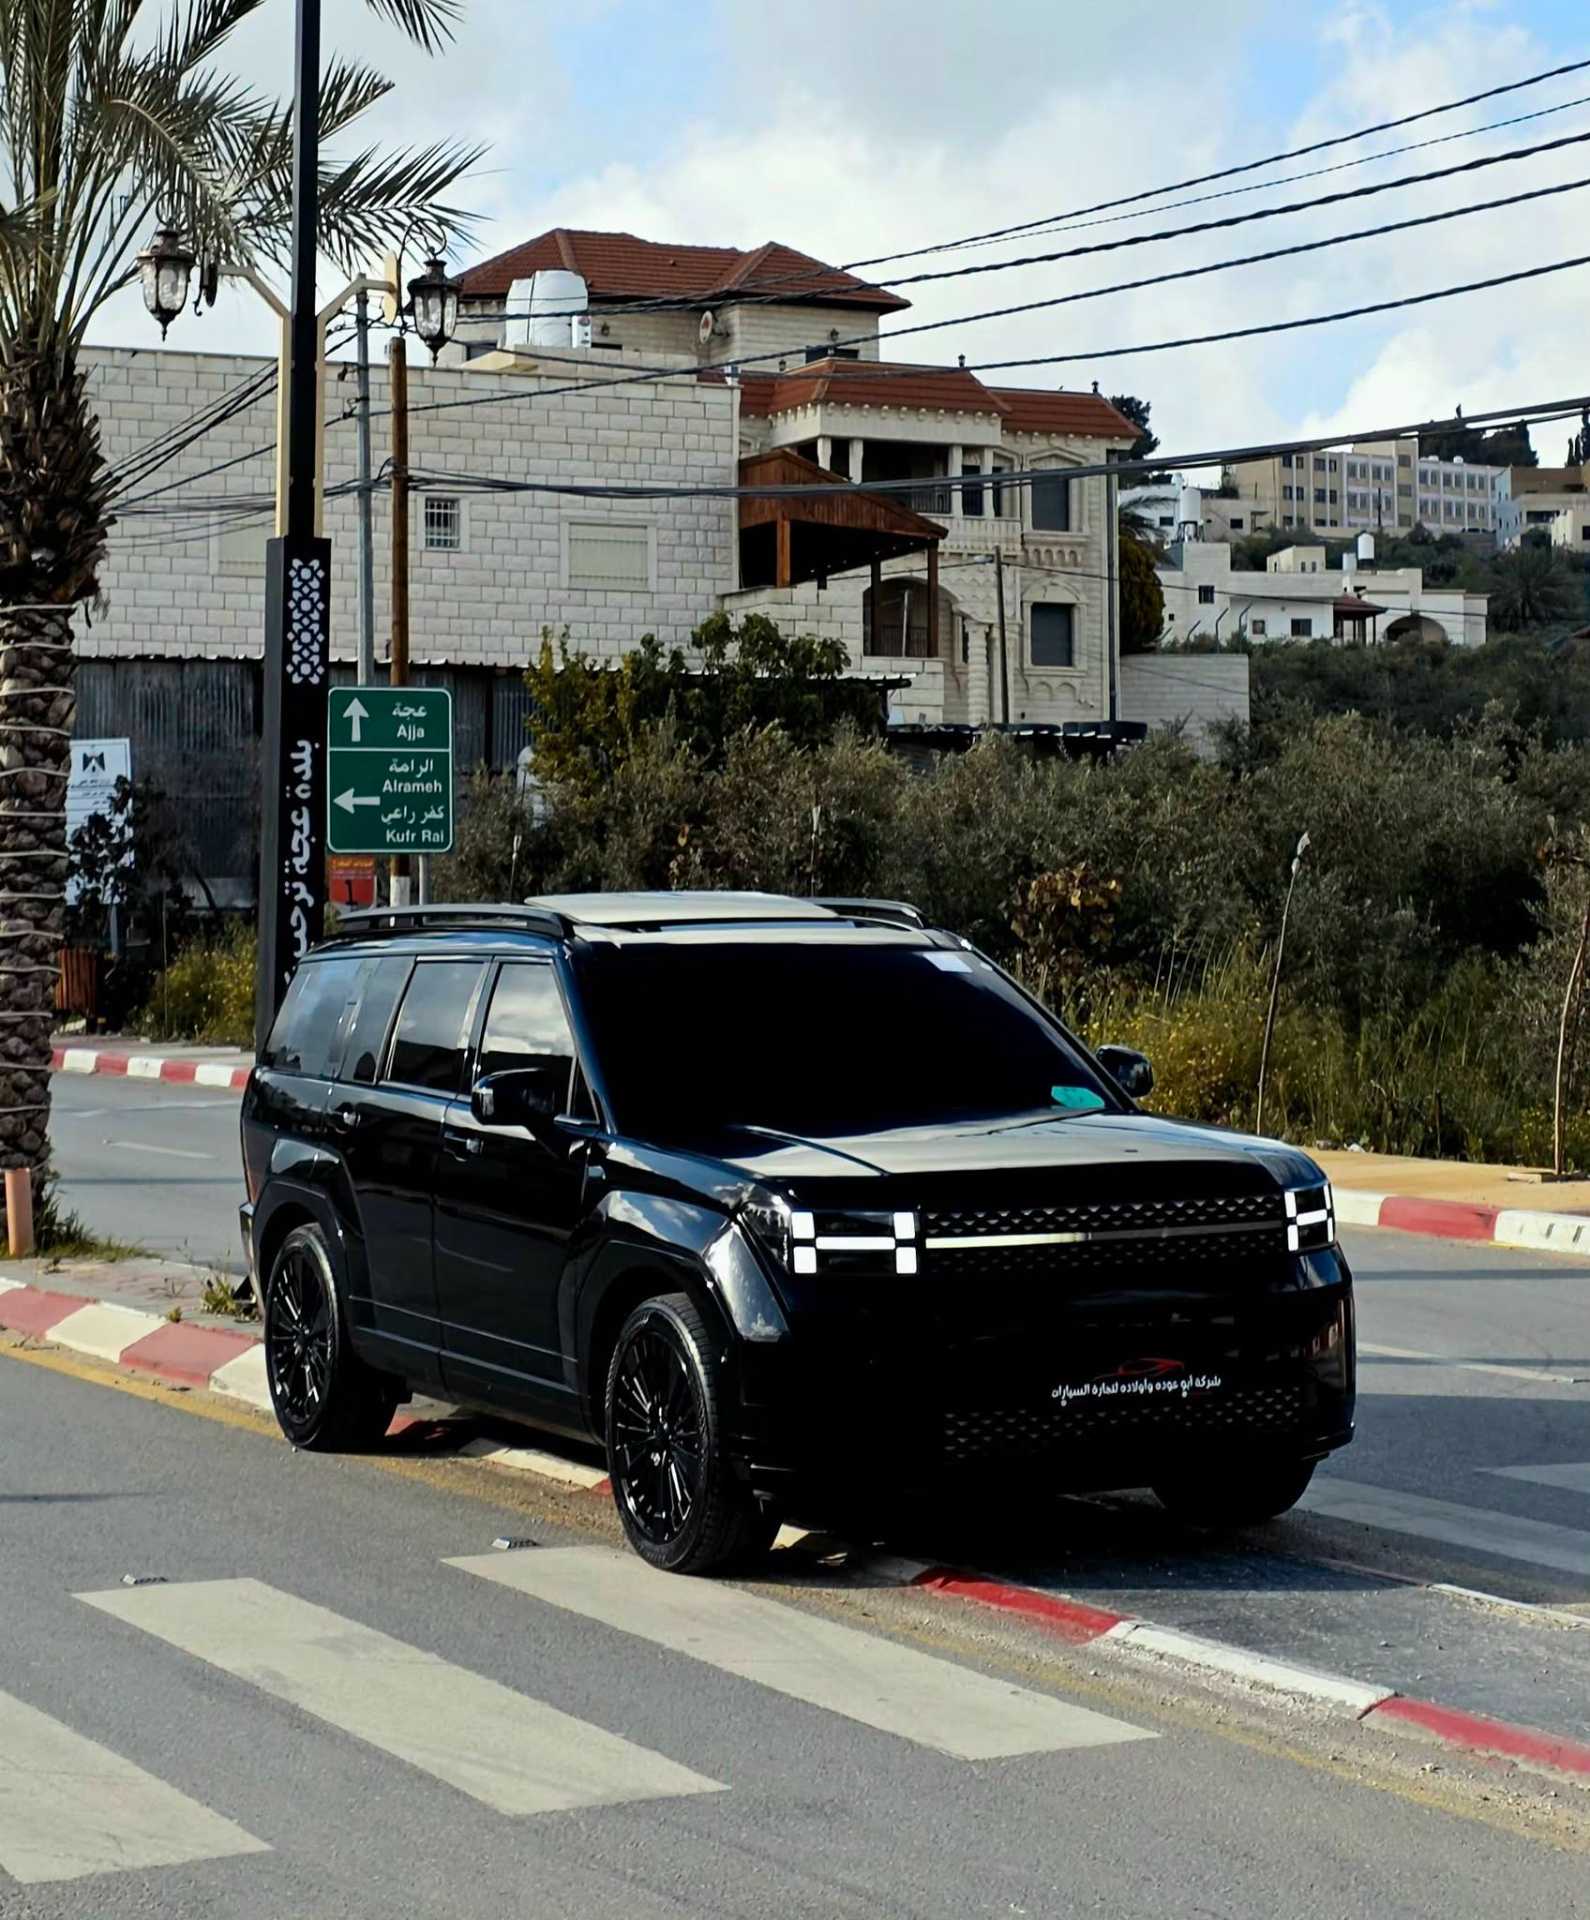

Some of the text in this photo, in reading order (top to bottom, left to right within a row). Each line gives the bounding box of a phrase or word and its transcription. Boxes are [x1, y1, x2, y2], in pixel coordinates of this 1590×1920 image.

[392, 702, 427, 720] عجة
[396, 723, 425, 741] Ajja
[284, 739, 319, 799] بلدة
[388, 758, 434, 778] الرامة
[382, 779, 442, 793] Alrameh
[381, 805, 444, 825] كفر راعي
[284, 806, 316, 874] عجة
[385, 829, 417, 843] Kufr
[1194, 1374, 1222, 1389] شركة
